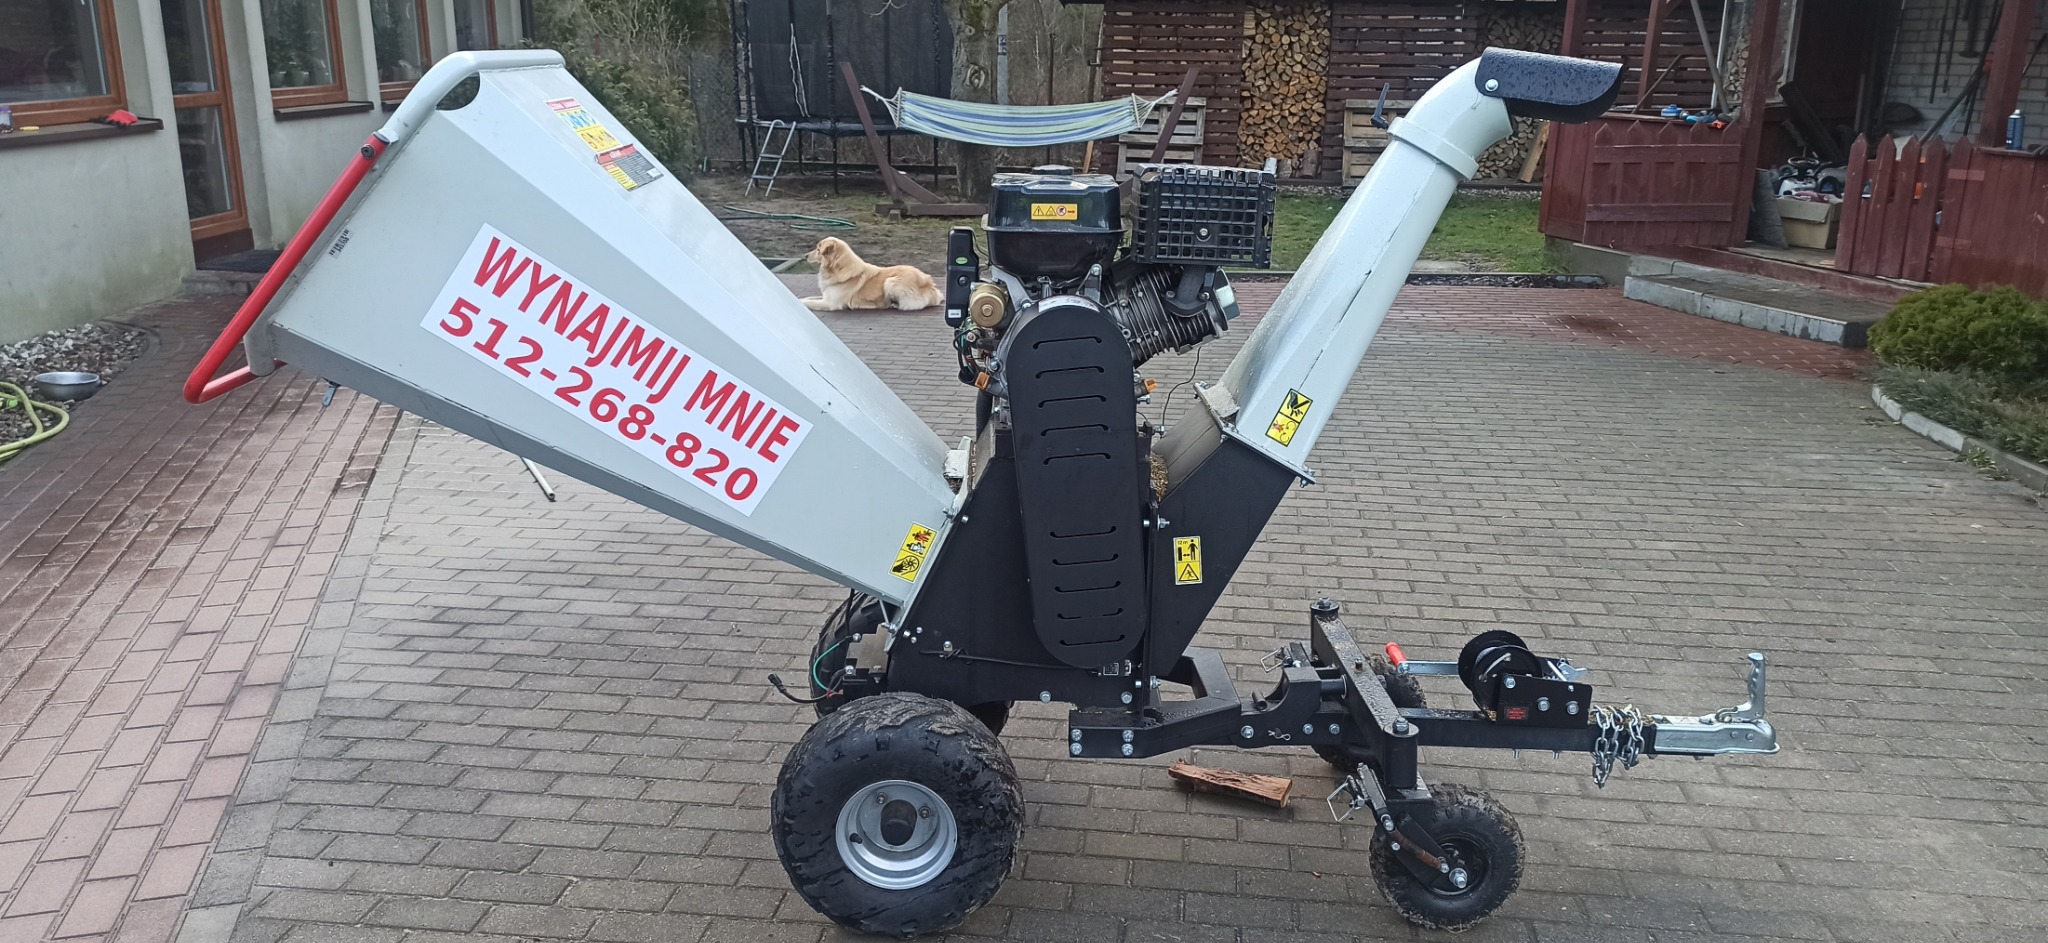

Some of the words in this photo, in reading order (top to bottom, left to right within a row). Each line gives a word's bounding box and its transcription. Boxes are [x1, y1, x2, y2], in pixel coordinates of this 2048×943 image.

[439, 296, 760, 502] 512-268-820
[474, 237, 692, 405] WYNAJMIJ
[684, 369, 801, 464] MNIE
